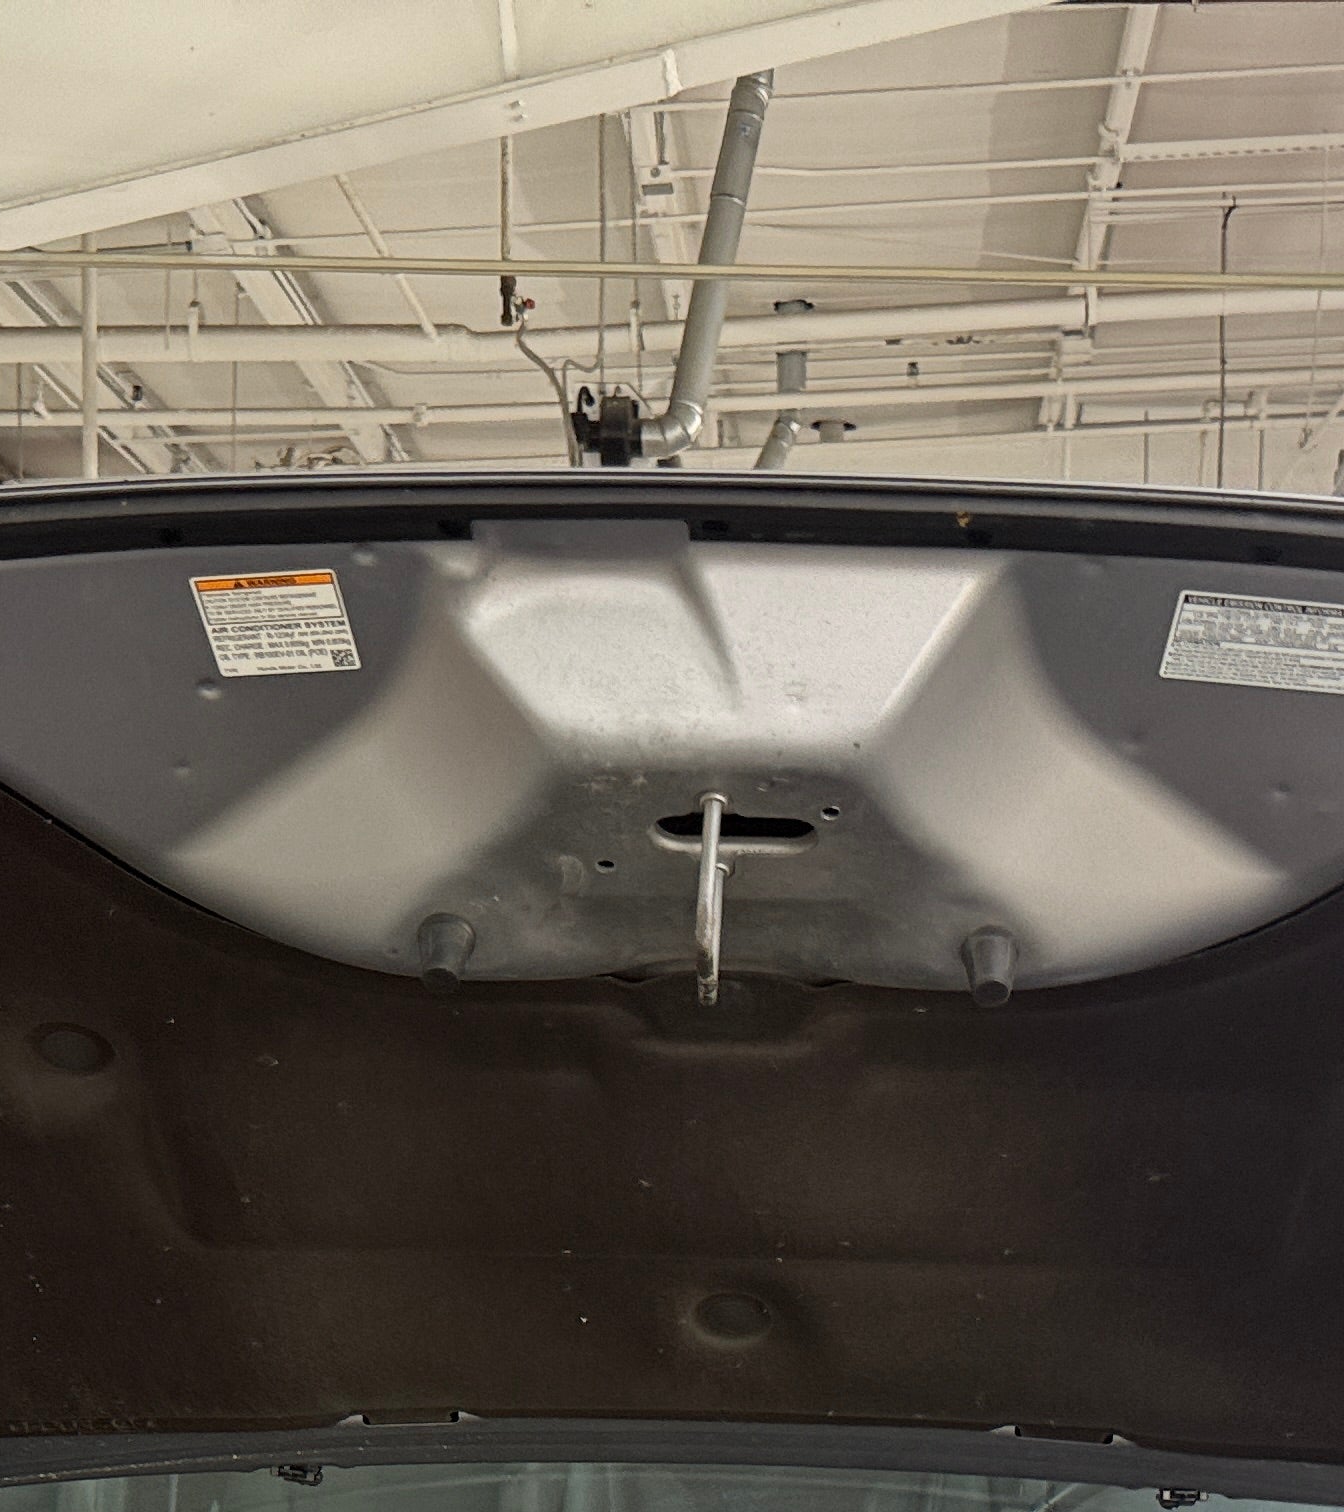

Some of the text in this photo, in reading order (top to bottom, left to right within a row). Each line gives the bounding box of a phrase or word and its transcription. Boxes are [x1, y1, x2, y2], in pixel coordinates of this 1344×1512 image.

[247, 577, 298, 588] WARNING
[211, 626, 229, 634] AIR
[231, 623, 302, 633] CONDITIONER
[304, 620, 346, 630] SYSTEM
